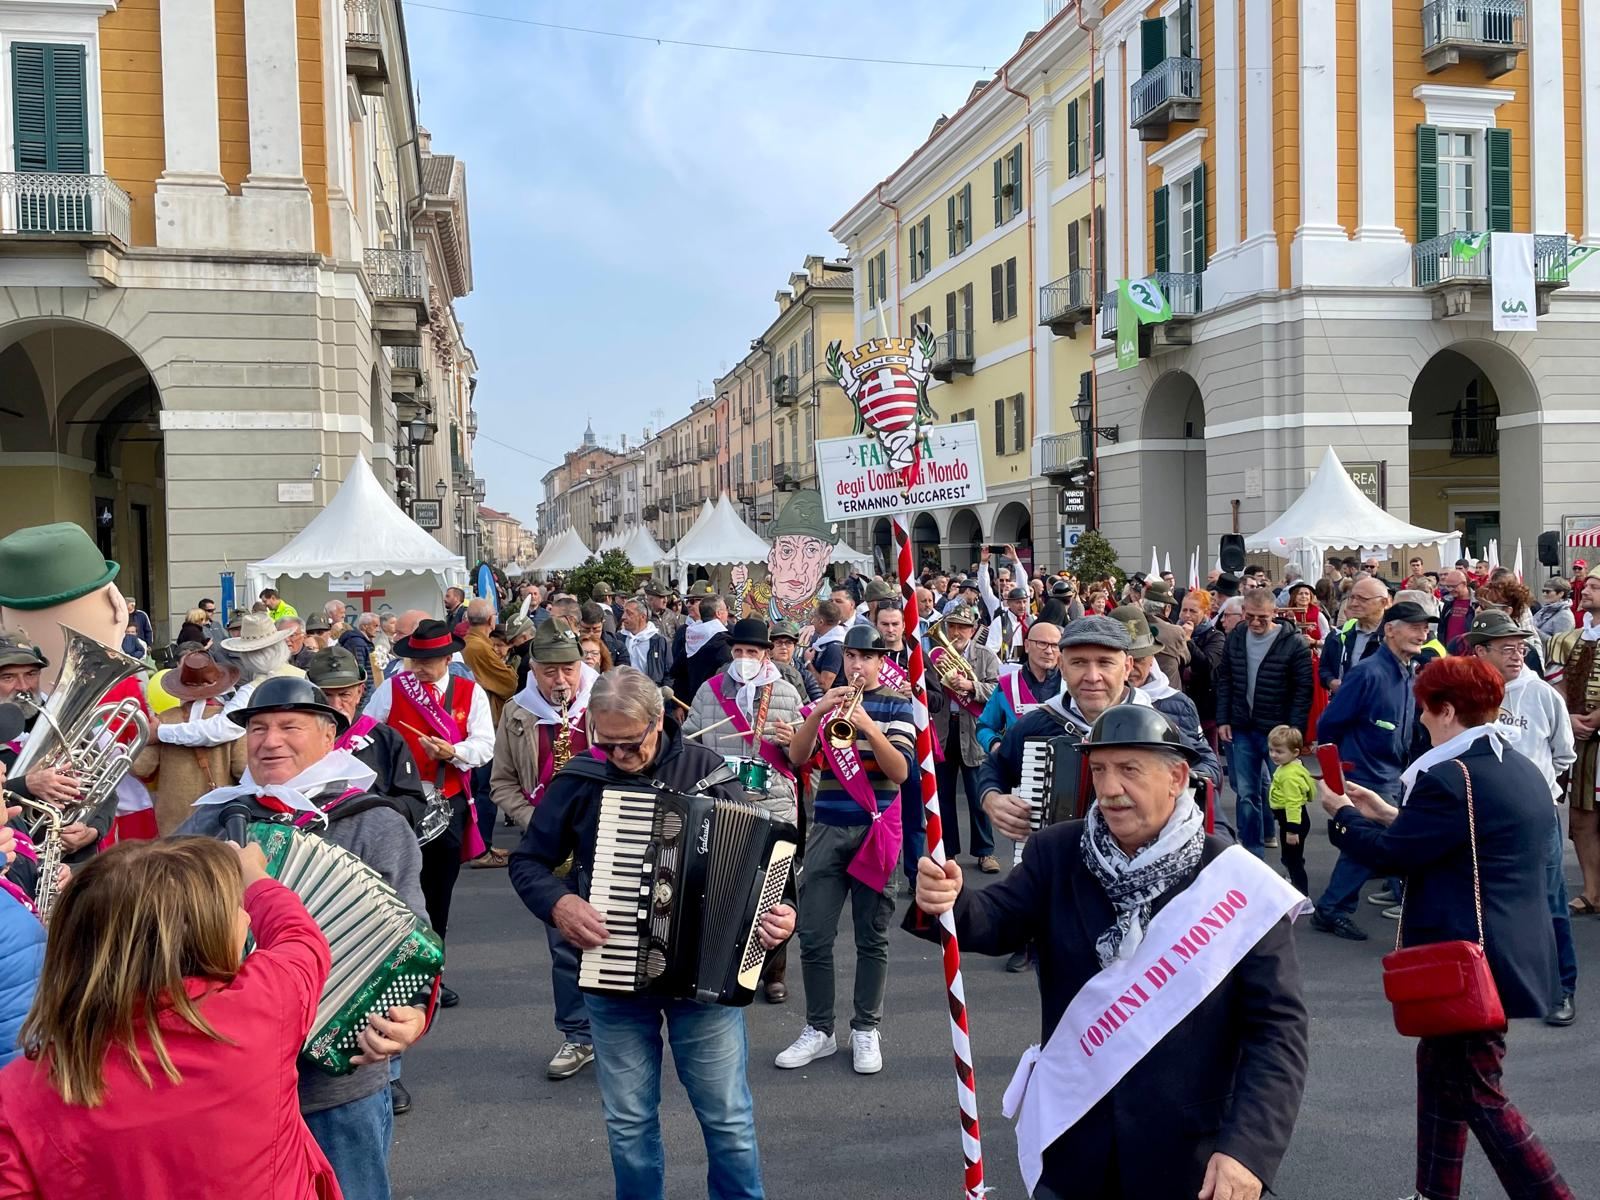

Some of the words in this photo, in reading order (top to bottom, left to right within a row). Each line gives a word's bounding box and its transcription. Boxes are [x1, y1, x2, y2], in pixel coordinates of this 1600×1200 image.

[855, 356, 907, 374] CUNEO
[836, 475, 865, 499] degli
[927, 458, 968, 484] Mondo
[1079, 982, 1150, 1057] UOMINI
[1143, 956, 1178, 991] DI
[1171, 888, 1248, 965] MONDO
